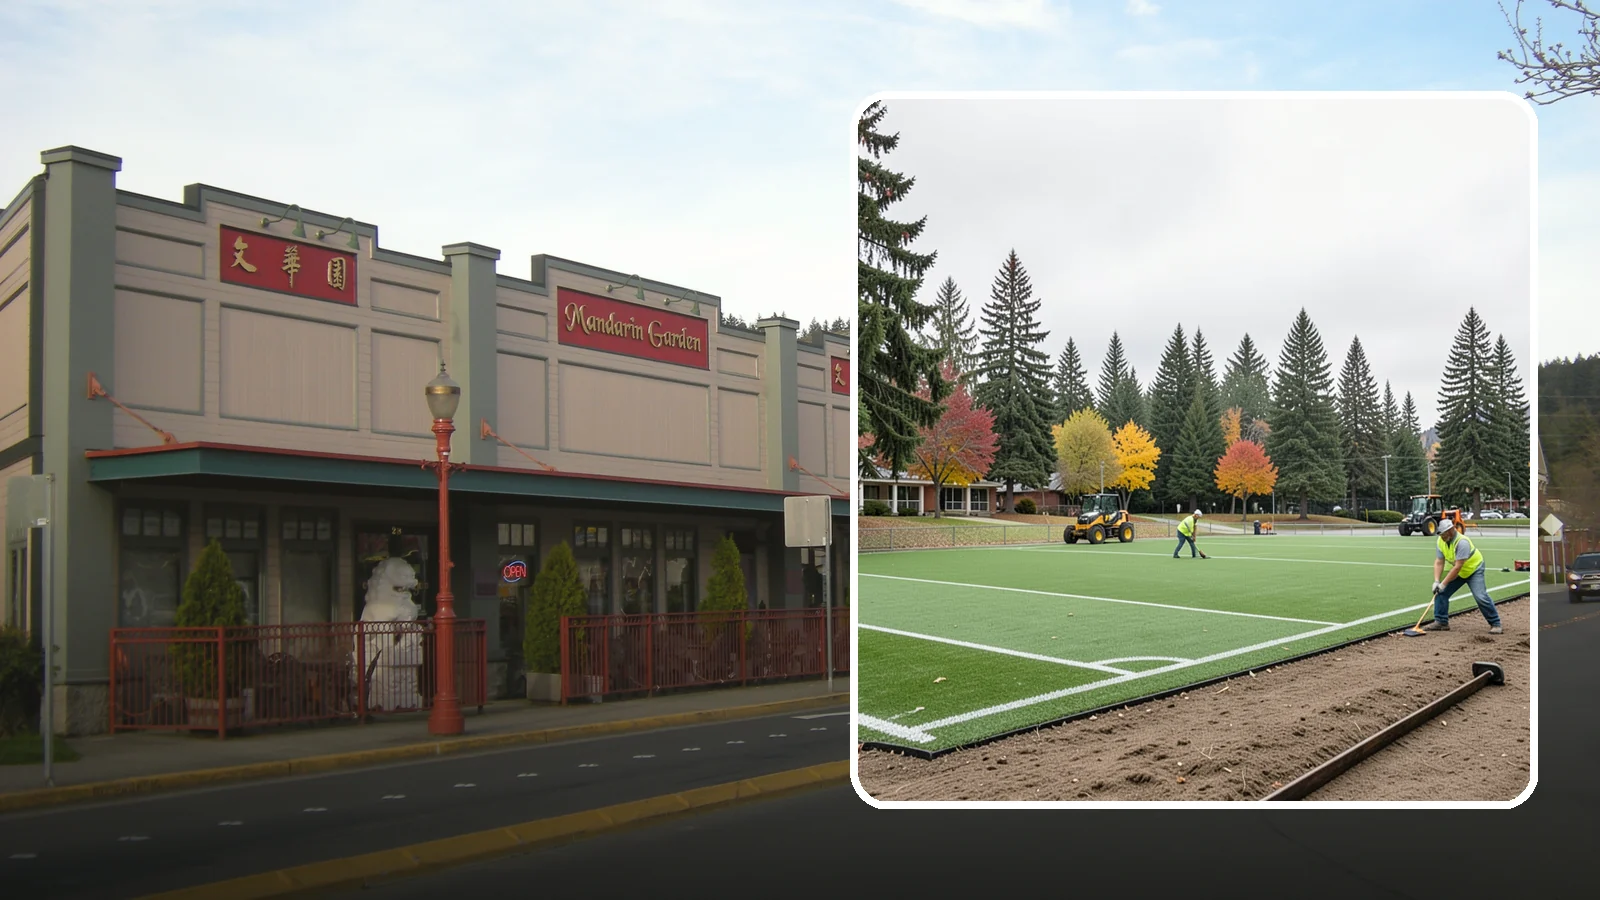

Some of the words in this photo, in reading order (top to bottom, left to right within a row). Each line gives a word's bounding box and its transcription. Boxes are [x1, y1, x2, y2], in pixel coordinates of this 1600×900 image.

[564, 302, 644, 341] Mandarin
[648, 320, 701, 352] Garden
[503, 565, 527, 578] OPEN
